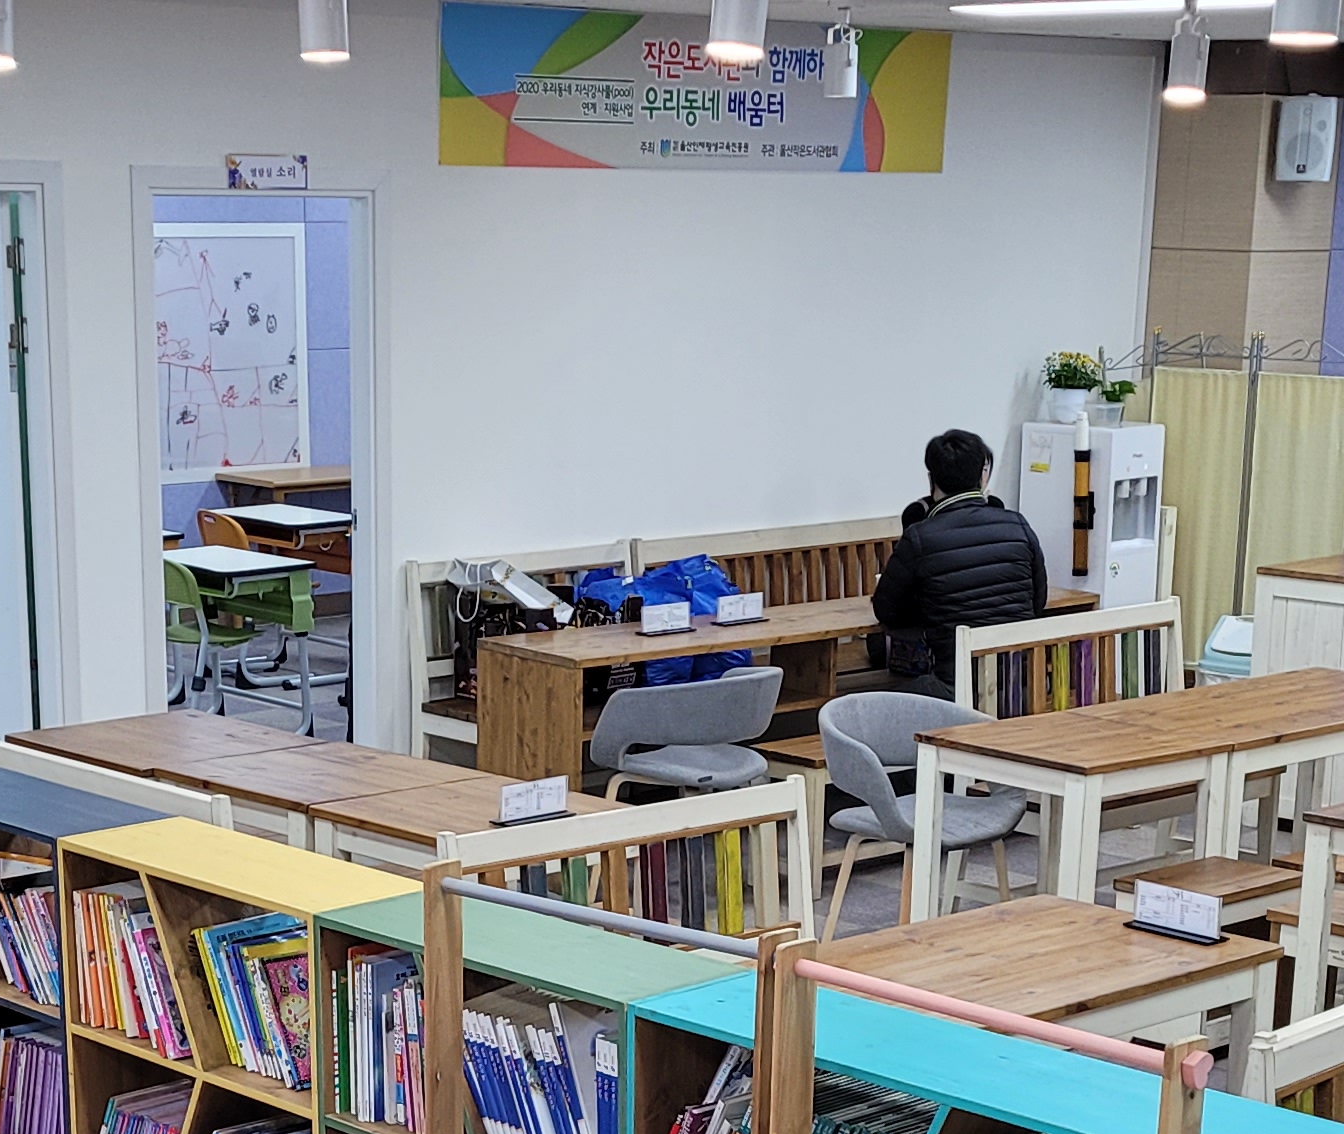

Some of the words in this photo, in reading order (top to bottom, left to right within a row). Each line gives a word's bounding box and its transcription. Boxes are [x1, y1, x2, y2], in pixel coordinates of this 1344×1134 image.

[768, 46, 825, 84] 함께하
[517, 81, 539, 94] 2020
[541, 82, 572, 98] 우리동네
[581, 102, 597, 116] 연계
[603, 103, 634, 118] 지원사업
[641, 86, 721, 126] 우리동네
[727, 90, 785, 127] 배움터
[640, 141, 655, 155] 주최
[761, 144, 775, 157] 주관
[276, 165, 296, 179] 소리
